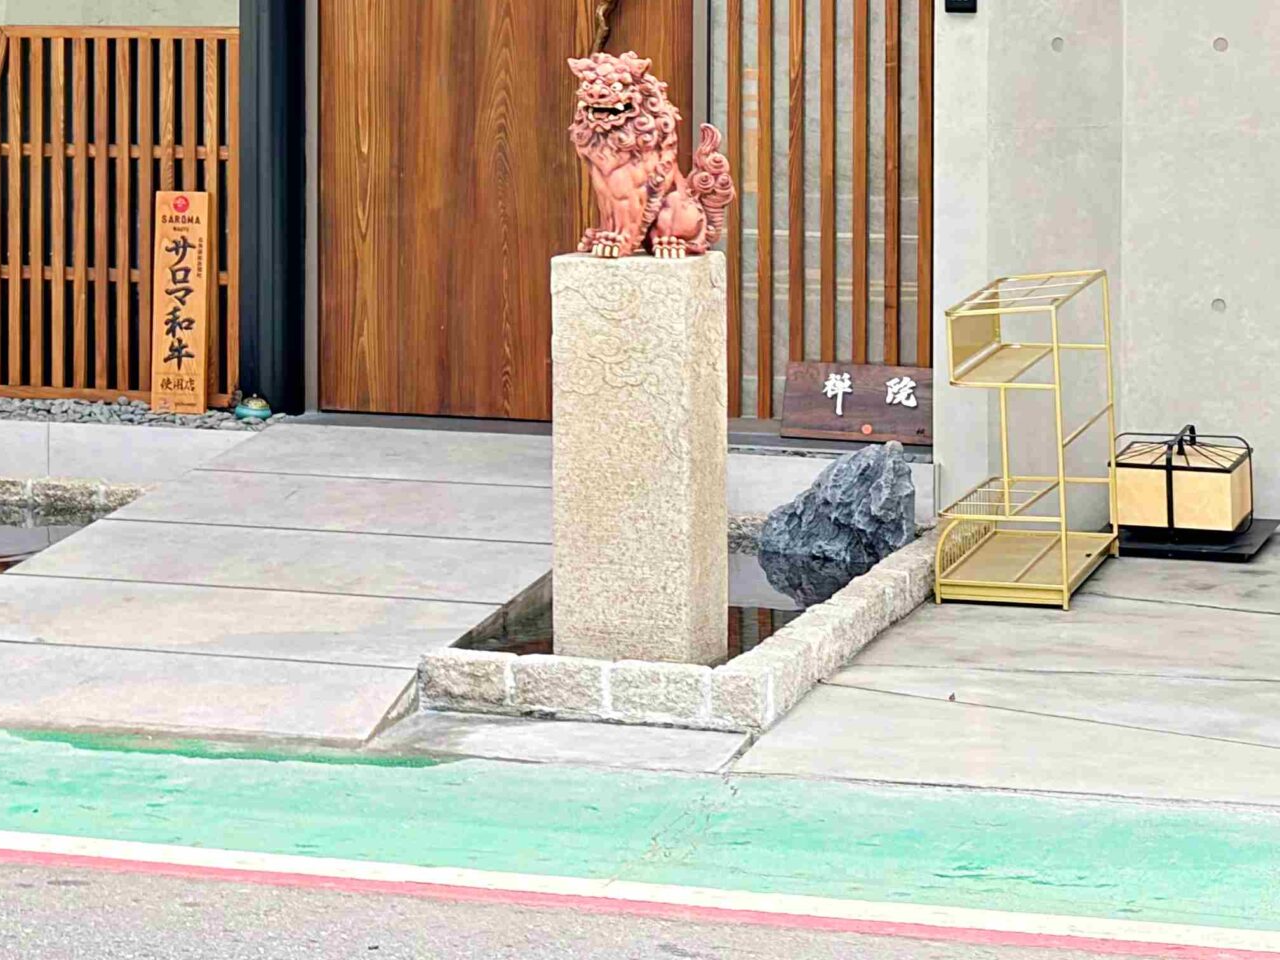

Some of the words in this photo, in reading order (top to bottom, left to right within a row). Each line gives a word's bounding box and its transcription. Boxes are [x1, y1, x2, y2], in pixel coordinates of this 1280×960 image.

[161, 214, 201, 225] SAROMA
[163, 235, 196, 371] サロマ和牛
